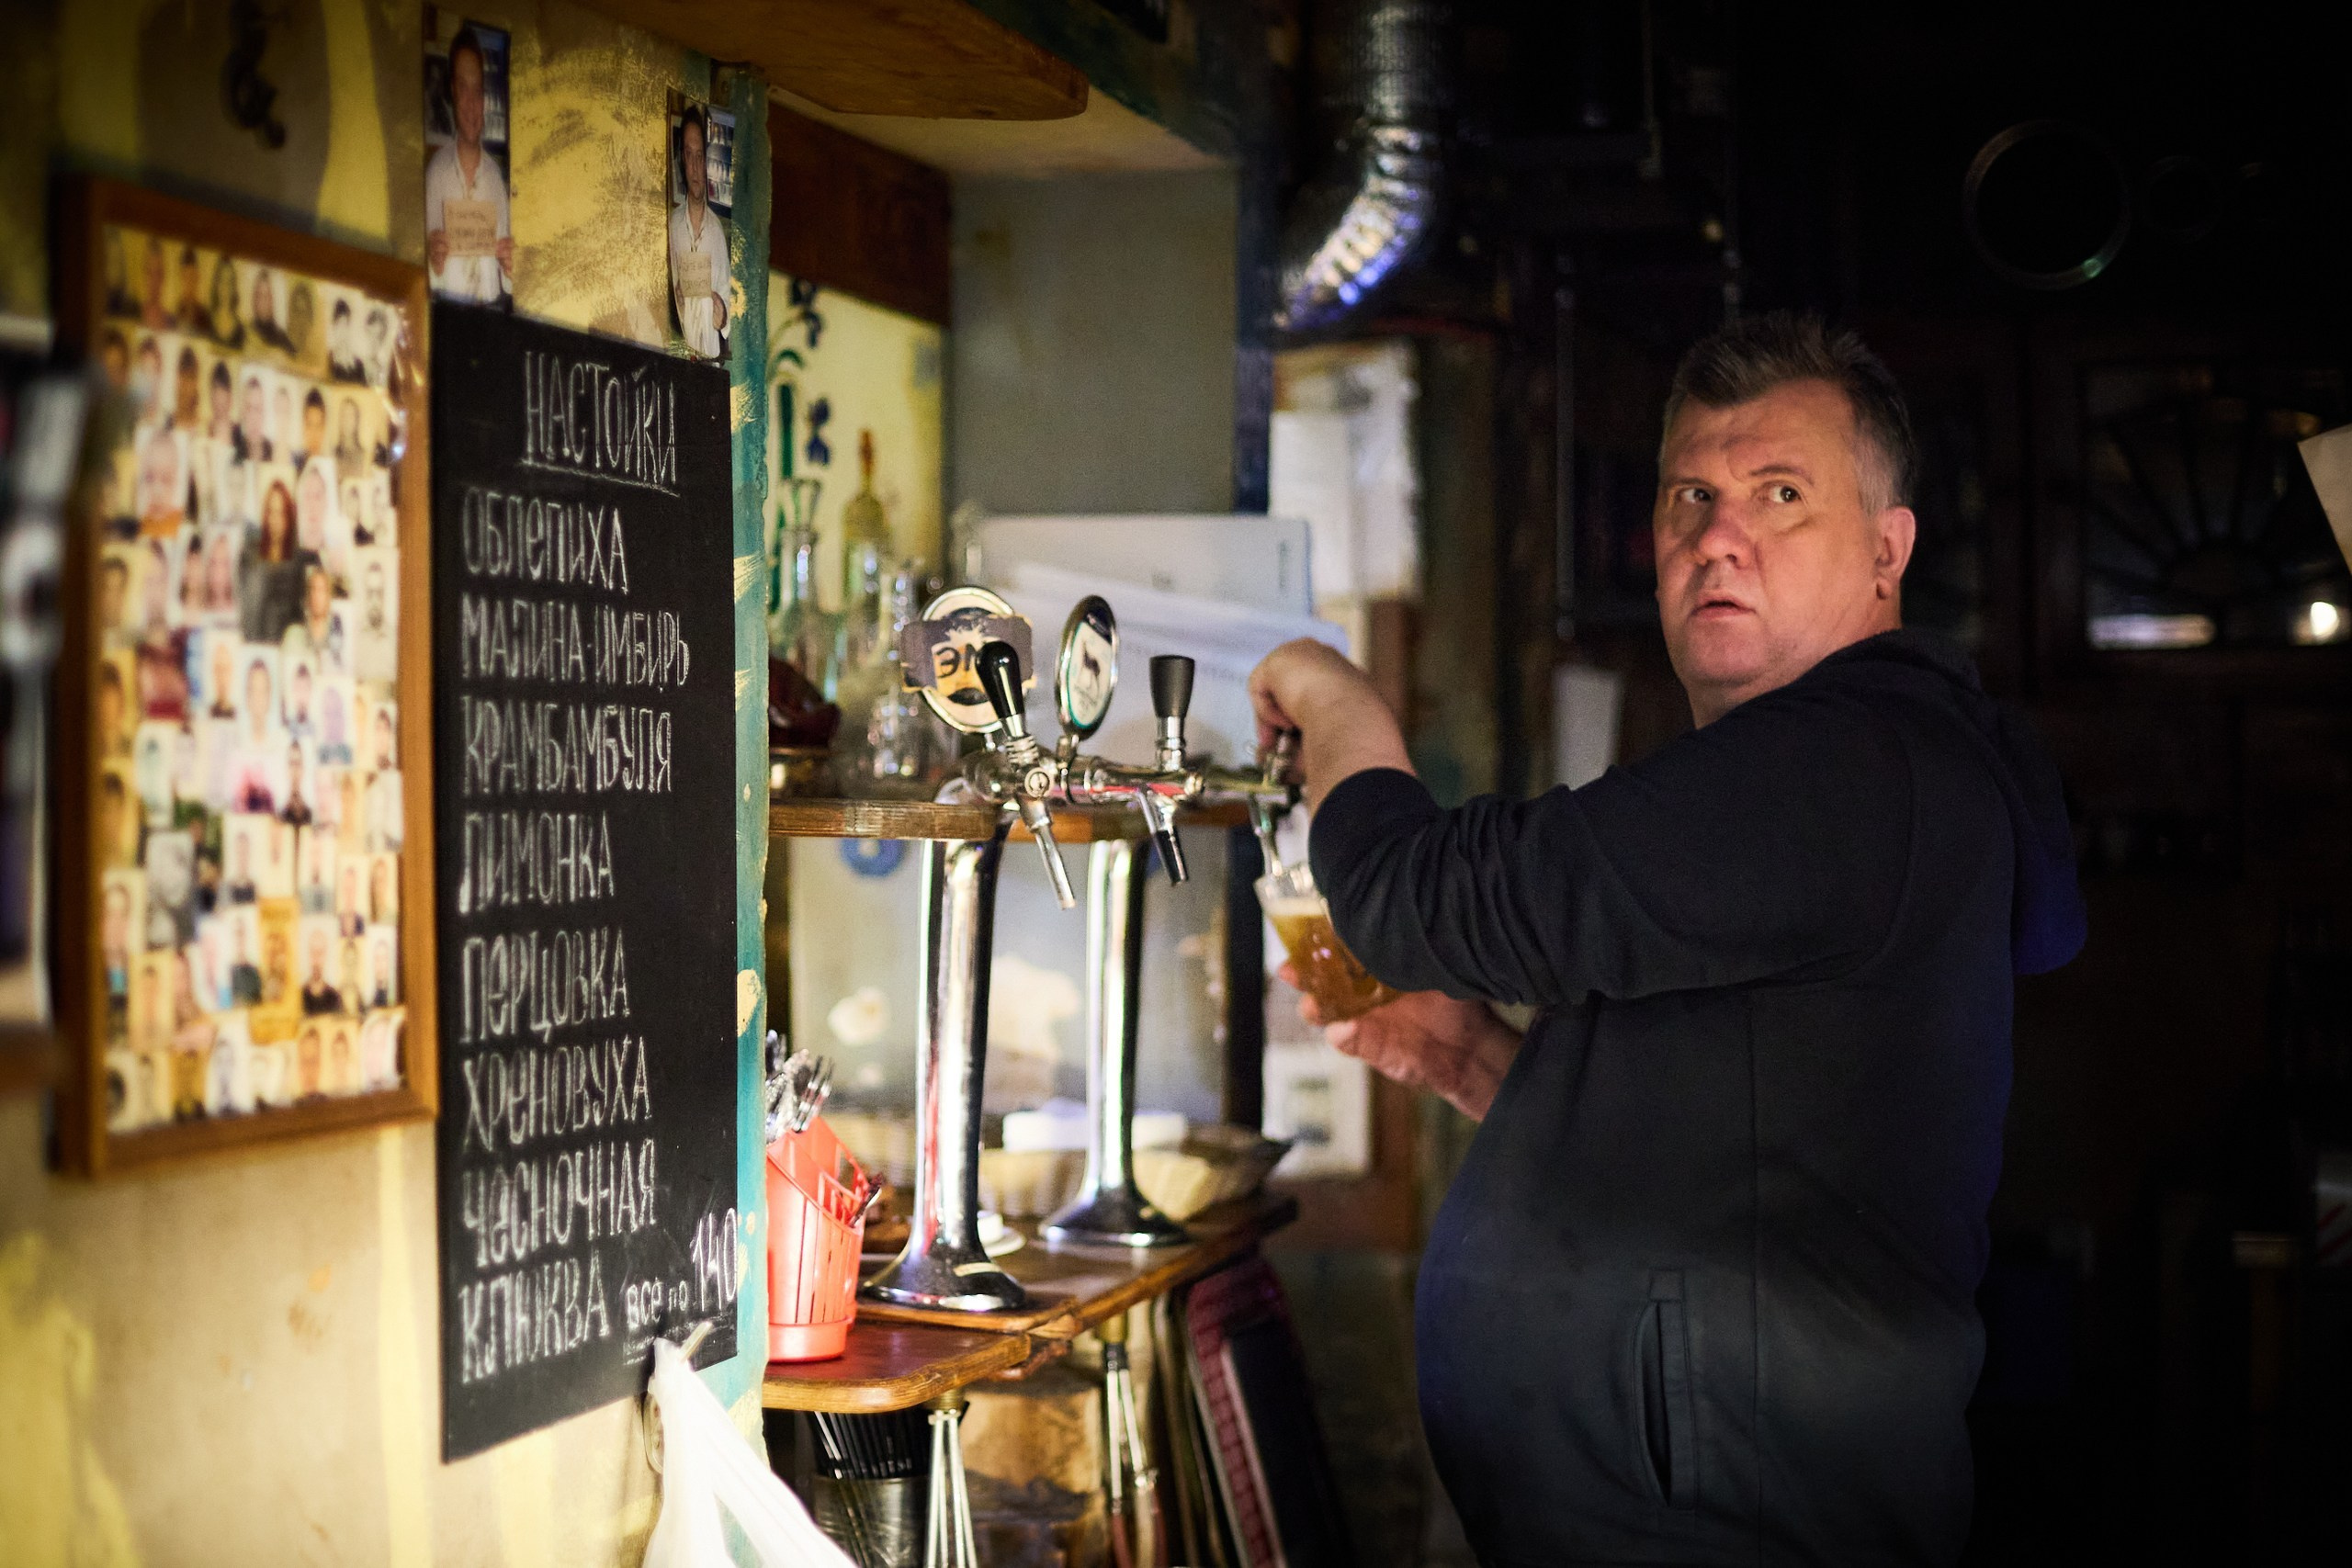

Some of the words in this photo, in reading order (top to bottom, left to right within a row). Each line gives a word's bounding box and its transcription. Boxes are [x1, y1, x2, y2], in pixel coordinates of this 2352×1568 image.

[526, 352, 677, 485] НАСТОЙКИ
[461, 696, 673, 794] КРАМБАМБУЛЯ
[458, 809, 615, 916] ЛИМОНКА
[690, 1208, 738, 1312] 140
[459, 1249, 610, 1383] КЛЮКВА
